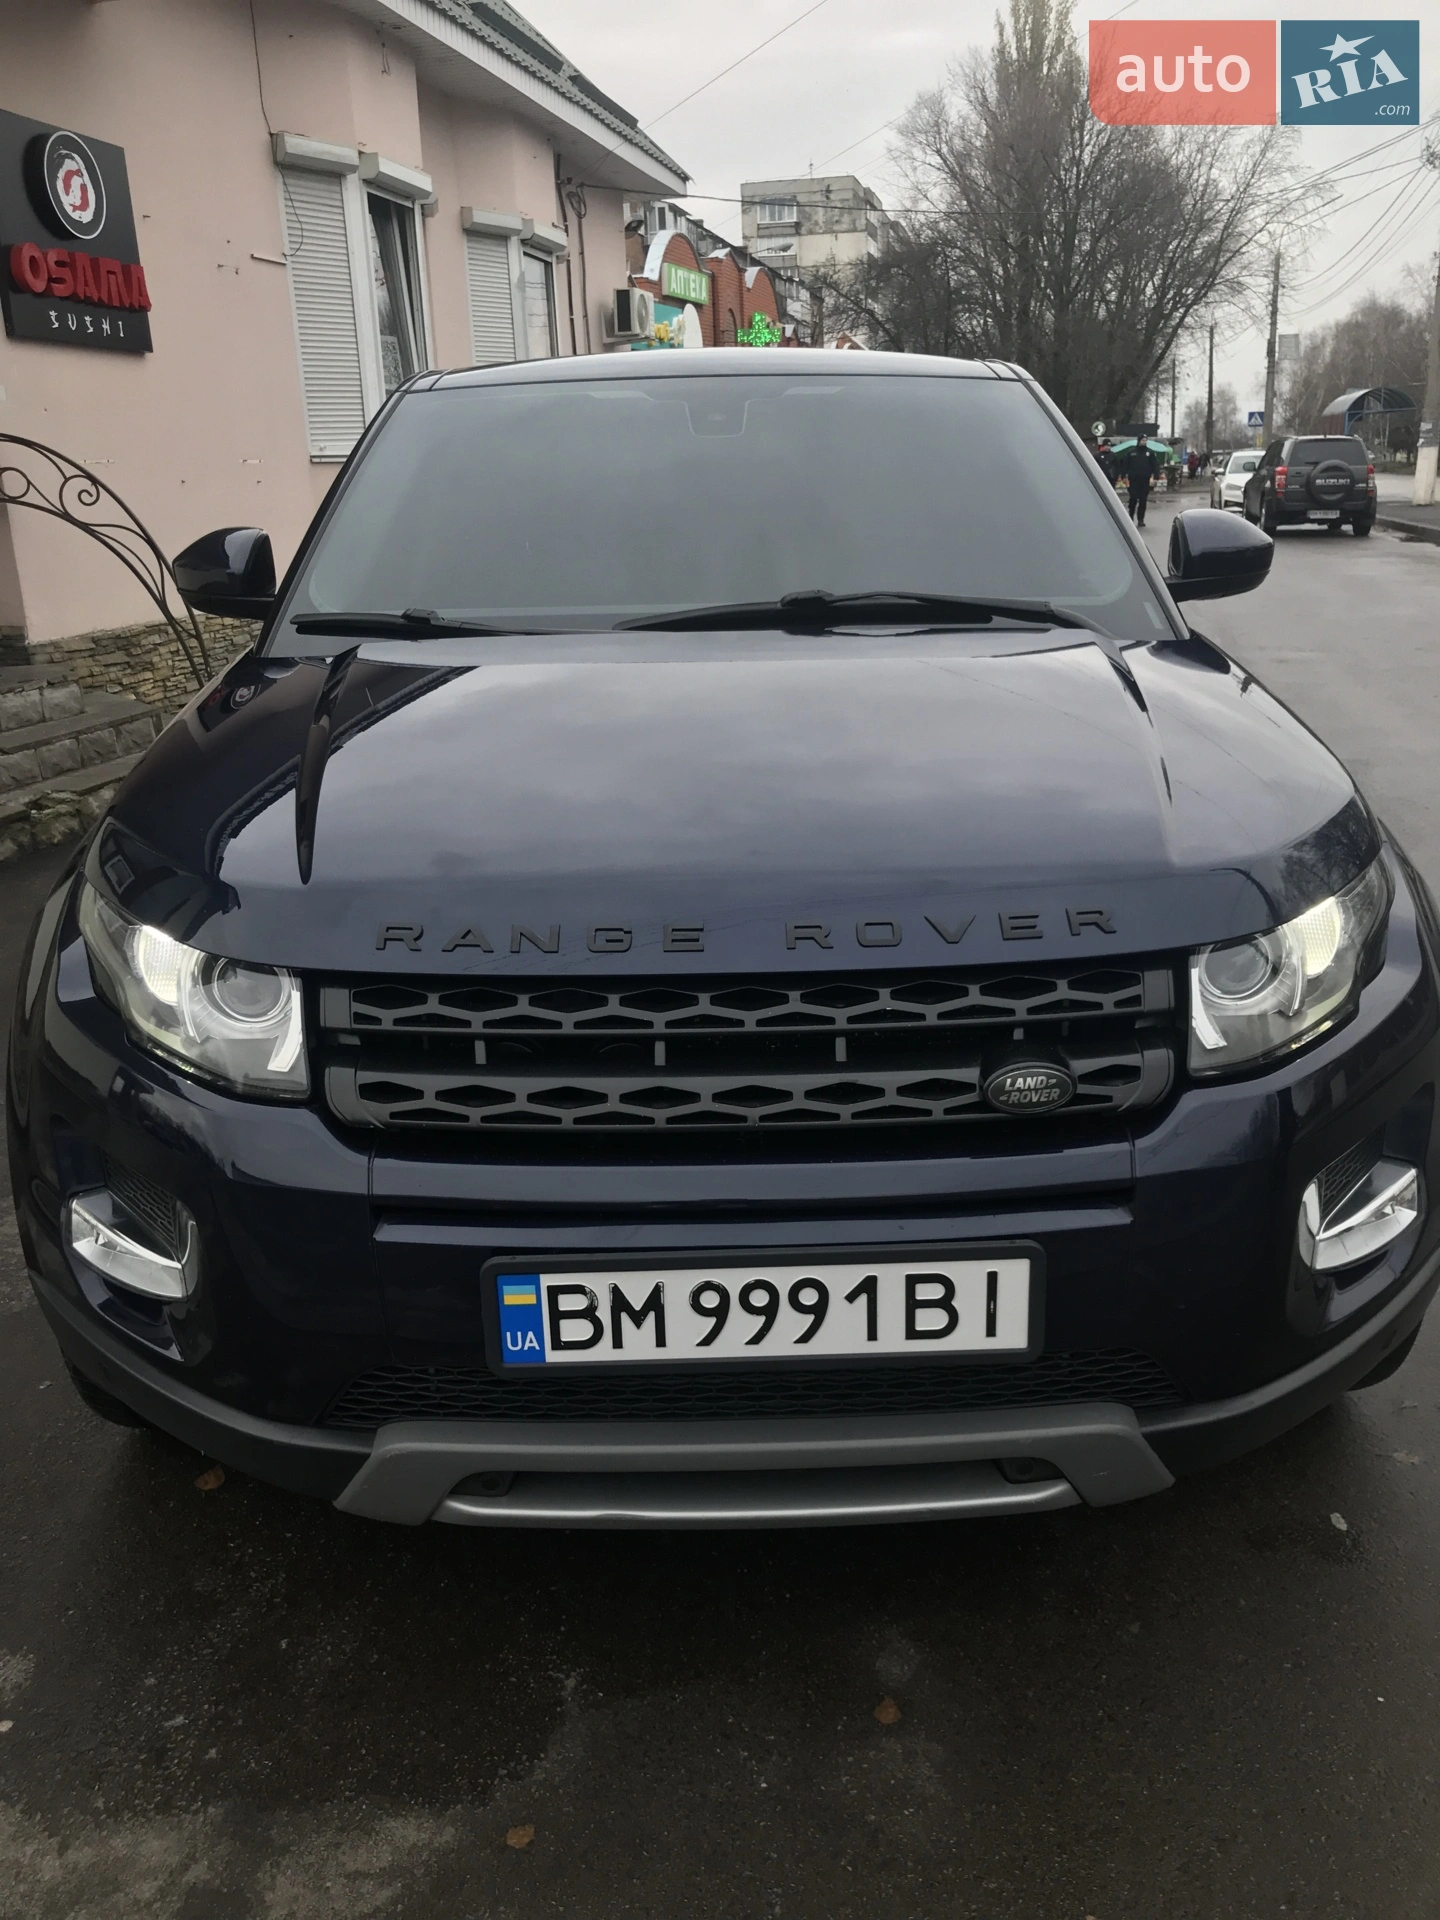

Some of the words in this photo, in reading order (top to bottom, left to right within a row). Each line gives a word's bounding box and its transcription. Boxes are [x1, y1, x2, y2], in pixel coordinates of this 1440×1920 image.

[10, 242, 152, 312] OSAMA
[49, 310, 124, 337] SUSHI
[1315, 478, 1350, 486] SUZUKI
[375, 922, 704, 953] RANGE
[784, 907, 1117, 950] ROVER
[1004, 1075, 1047, 1092] LAND
[1008, 1088, 1060, 1104] ROVER
[505, 1331, 540, 1352] UA
